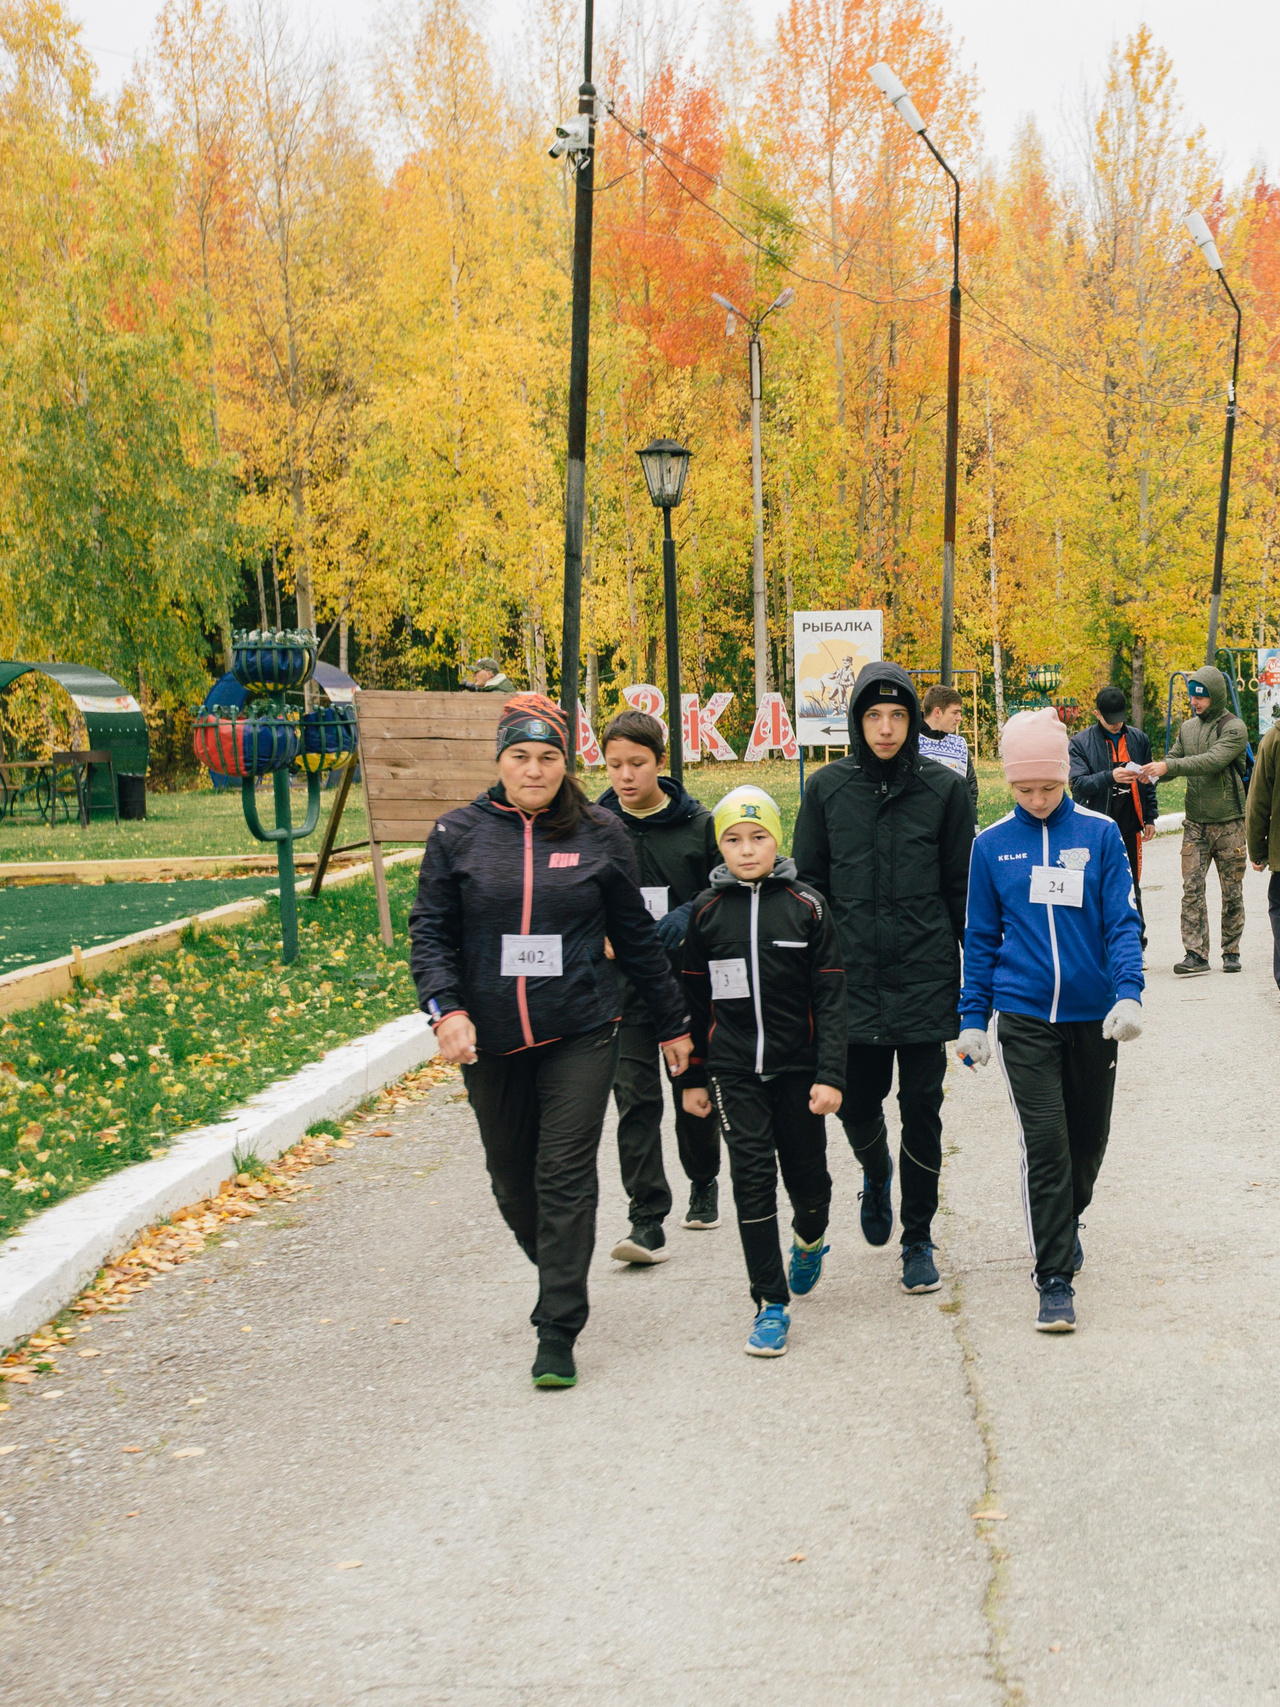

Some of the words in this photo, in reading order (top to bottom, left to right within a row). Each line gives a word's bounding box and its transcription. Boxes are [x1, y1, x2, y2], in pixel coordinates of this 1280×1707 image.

[802, 621, 873, 633] РЫБАЛКА
[998, 852, 1028, 861] KELME
[1048, 880, 1065, 893] 24
[518, 950, 545, 964] 402
[723, 974, 730, 987] 3
